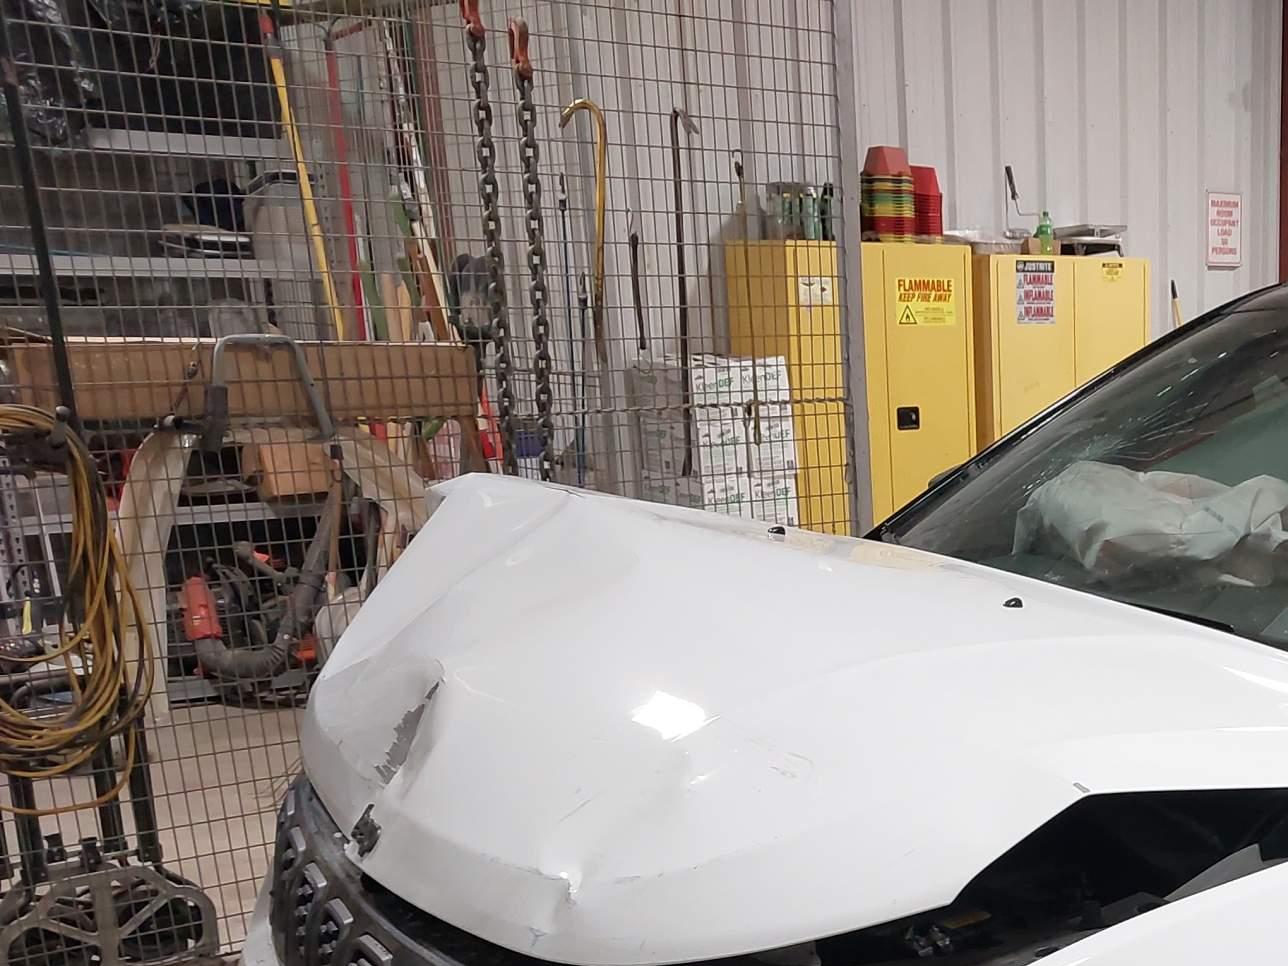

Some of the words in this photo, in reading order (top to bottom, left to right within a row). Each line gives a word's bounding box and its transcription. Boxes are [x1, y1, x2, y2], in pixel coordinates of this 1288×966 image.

[1217, 228, 1233, 236] LOAD
[1211, 247, 1237, 255] PERSONS
[897, 279, 953, 292] FLAMMABLE
[898, 292, 915, 302] KEEP
[916, 292, 932, 302] FIRE
[932, 293, 952, 303] AWAY
